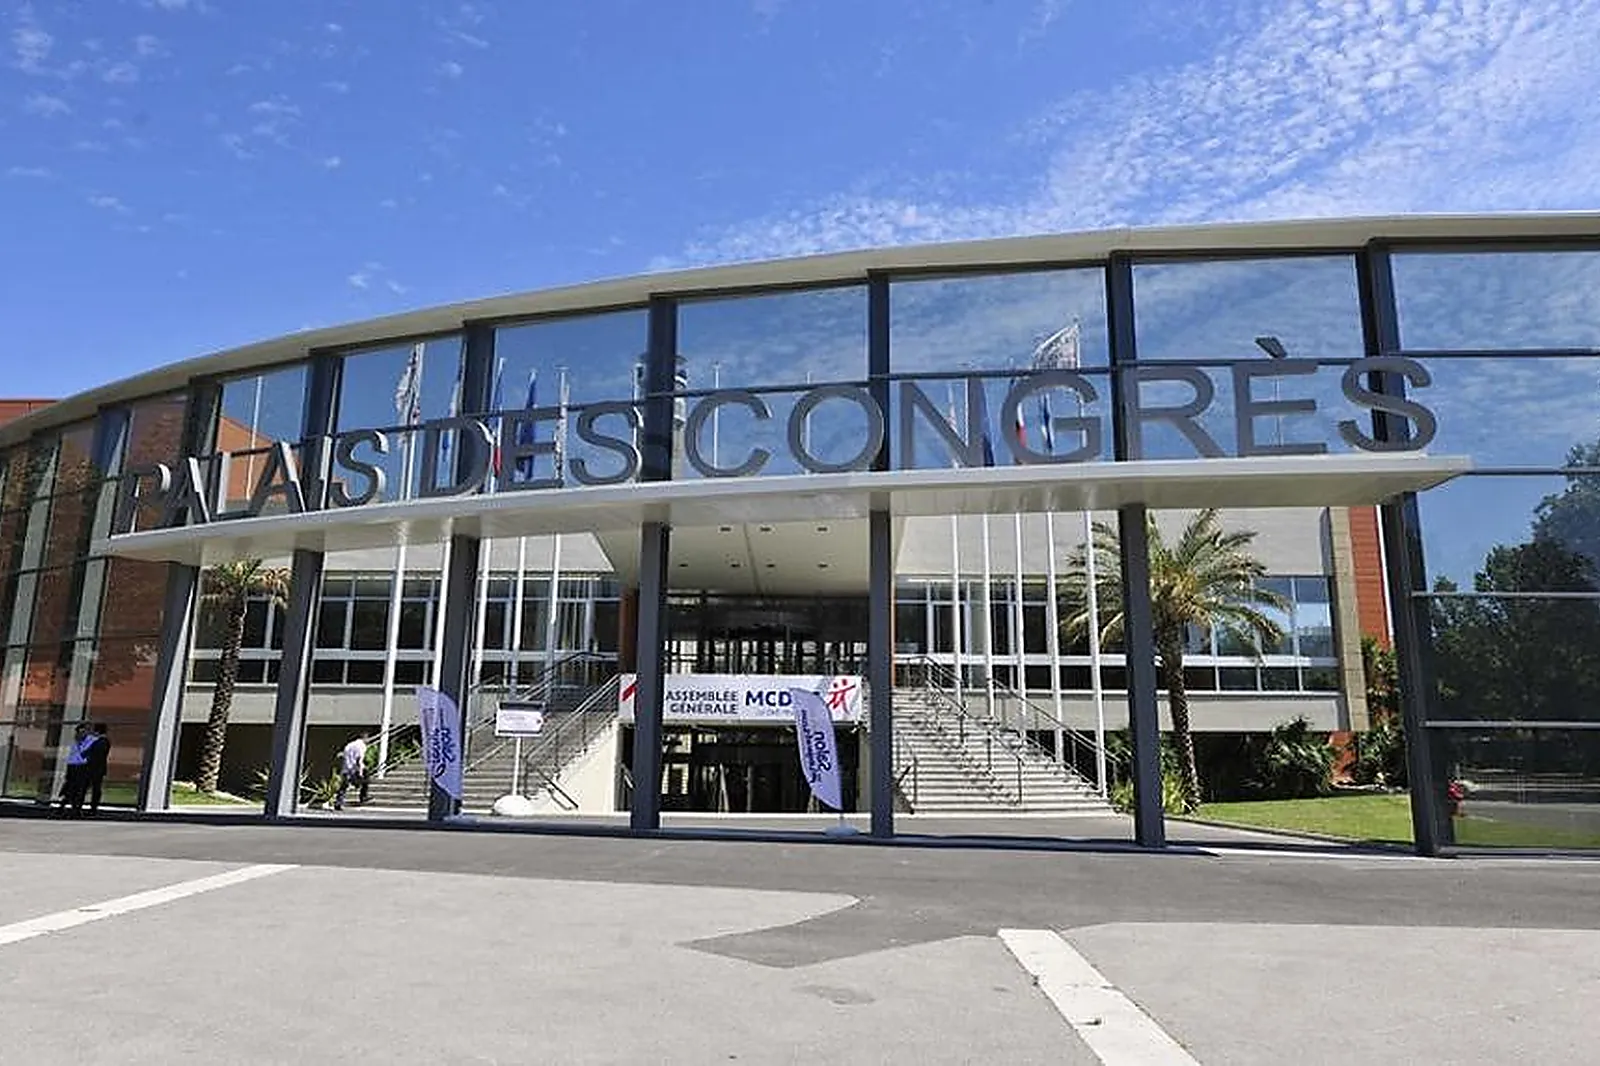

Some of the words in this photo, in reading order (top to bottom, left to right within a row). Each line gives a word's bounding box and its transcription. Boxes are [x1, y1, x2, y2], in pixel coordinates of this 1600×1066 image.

[110, 430, 389, 538] PALAIS
[419, 401, 643, 496] DES
[684, 336, 1438, 478] CONGRÈS
[745, 690, 819, 707] MCD
